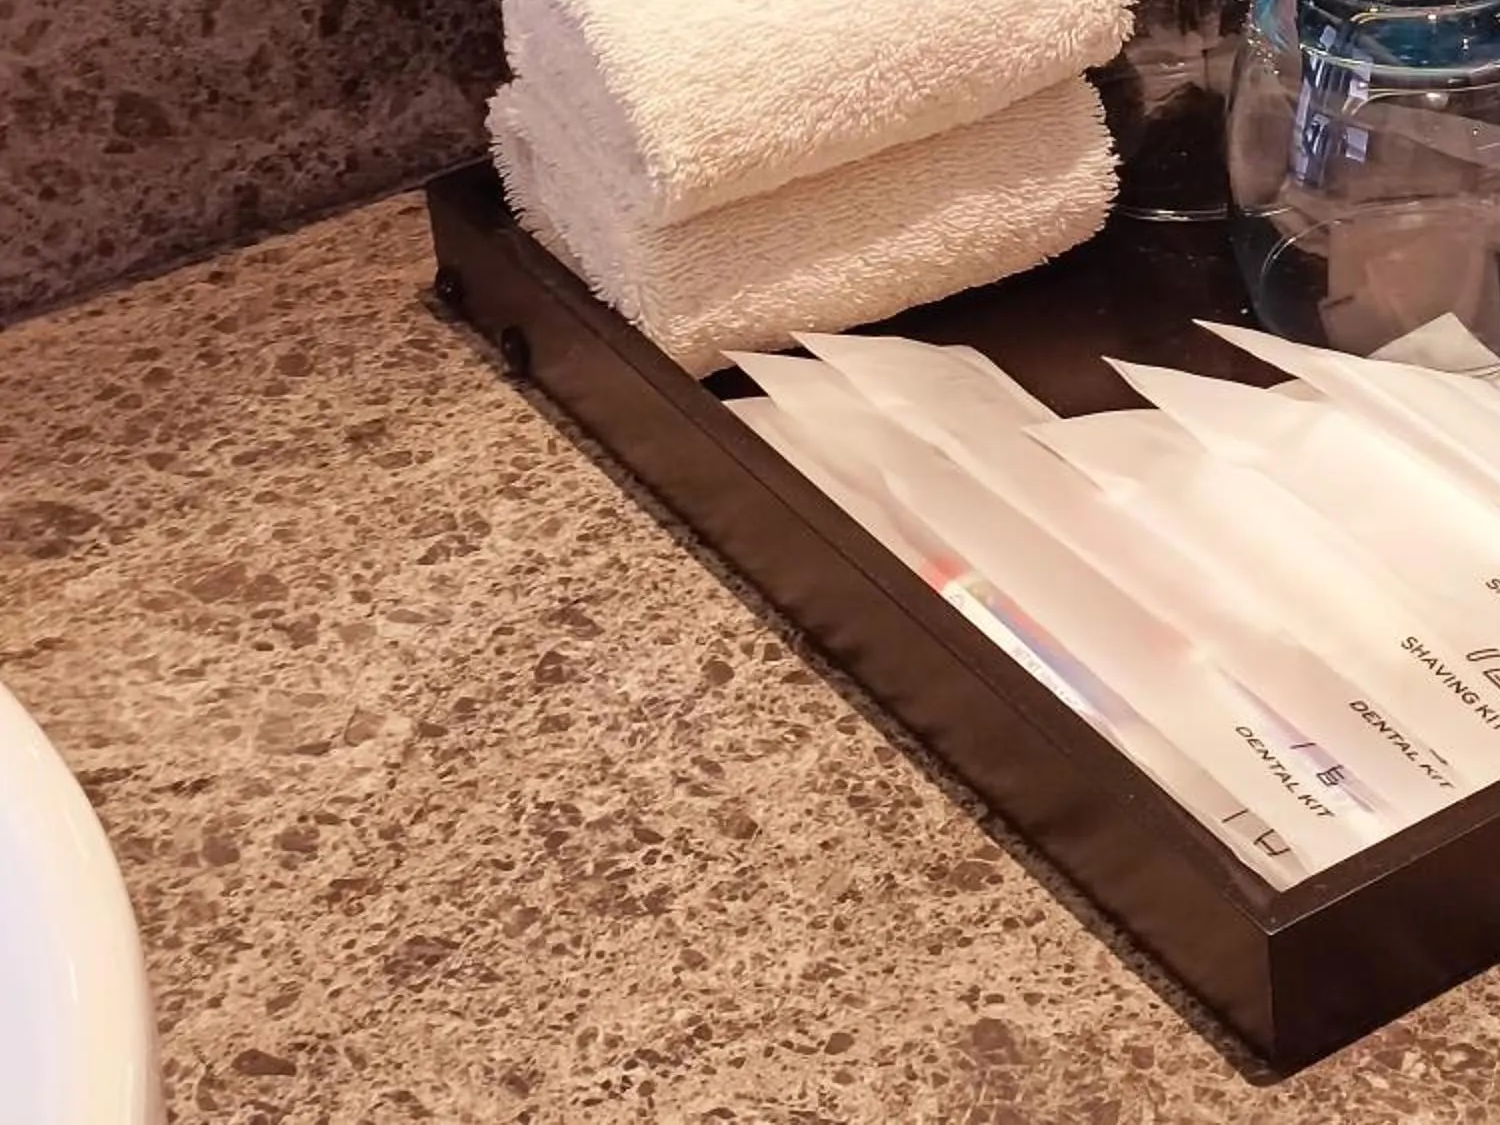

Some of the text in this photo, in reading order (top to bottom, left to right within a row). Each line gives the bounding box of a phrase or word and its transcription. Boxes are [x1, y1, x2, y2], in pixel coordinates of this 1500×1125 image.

[1400, 636, 1479, 705] SHAVING
[1235, 725, 1335, 820] DENTAL KIT
[1349, 700, 1456, 790] DENTAL KIT
